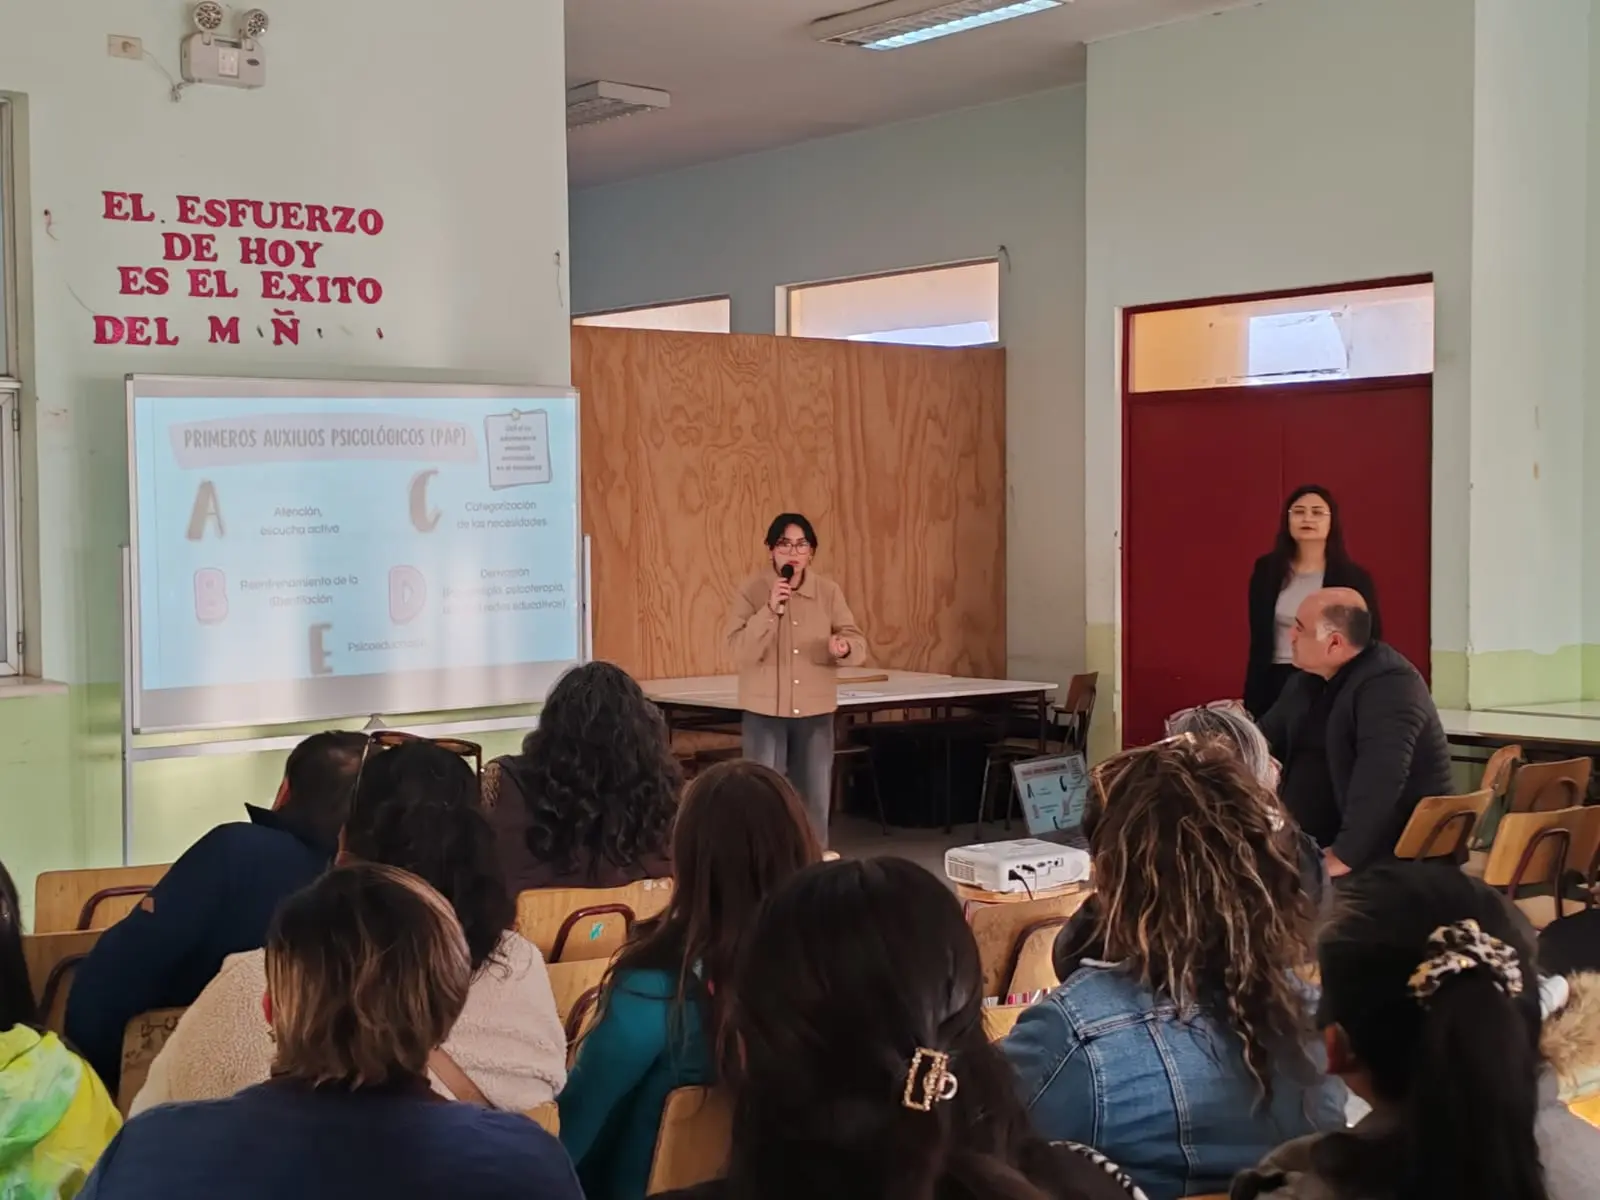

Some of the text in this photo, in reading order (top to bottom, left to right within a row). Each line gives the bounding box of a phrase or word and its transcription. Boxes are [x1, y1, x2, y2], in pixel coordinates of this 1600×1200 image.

[101, 190, 384, 235] EL ESFUERZO
[162, 232, 323, 268] DE HOY
[117, 266, 384, 304] ES EL EXITO
[92, 315, 179, 346] DEL
[184, 425, 467, 449] PRIMEROS AUXILIOS PSICOLÓGICOS (PAP)
[333, 575, 347, 586] de
[348, 574, 359, 586] la
